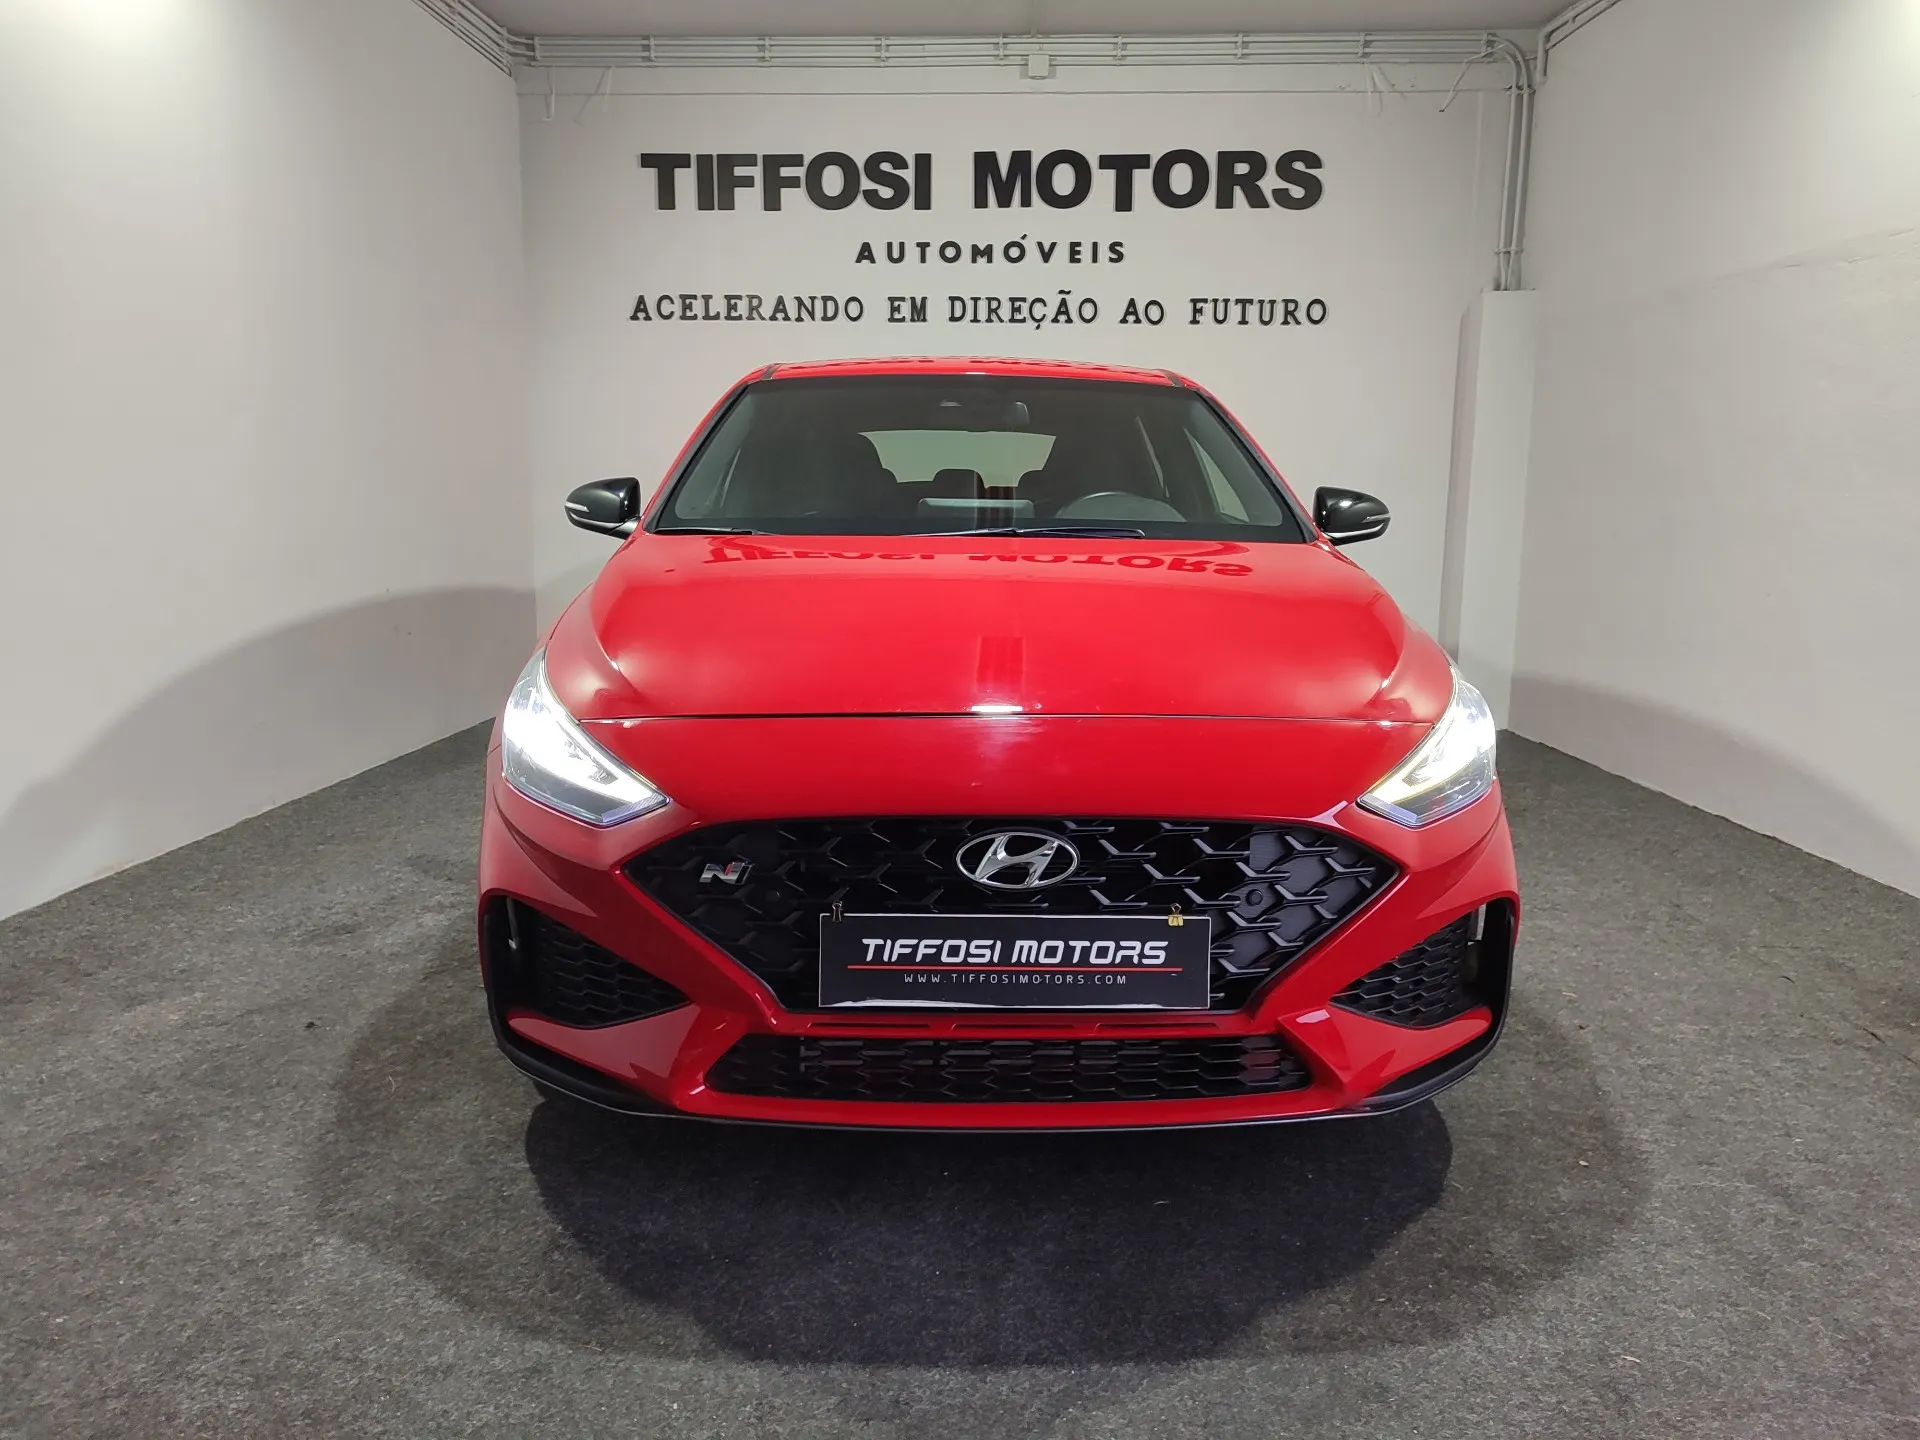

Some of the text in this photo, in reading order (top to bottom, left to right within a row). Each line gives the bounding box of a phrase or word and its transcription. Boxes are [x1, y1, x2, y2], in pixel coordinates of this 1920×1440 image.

[640, 148, 1323, 213] TIFFOSI MOTORS
[855, 233, 1125, 264] AUTOMÓVEIS
[629, 289, 1327, 331] ACELERANDO EM DIREÇÃO AO FUTURO
[861, 938, 1169, 965] TIFFOSI MOTORS
[904, 973, 1127, 985] WWW.TIFFOSIMOTORS.COM
